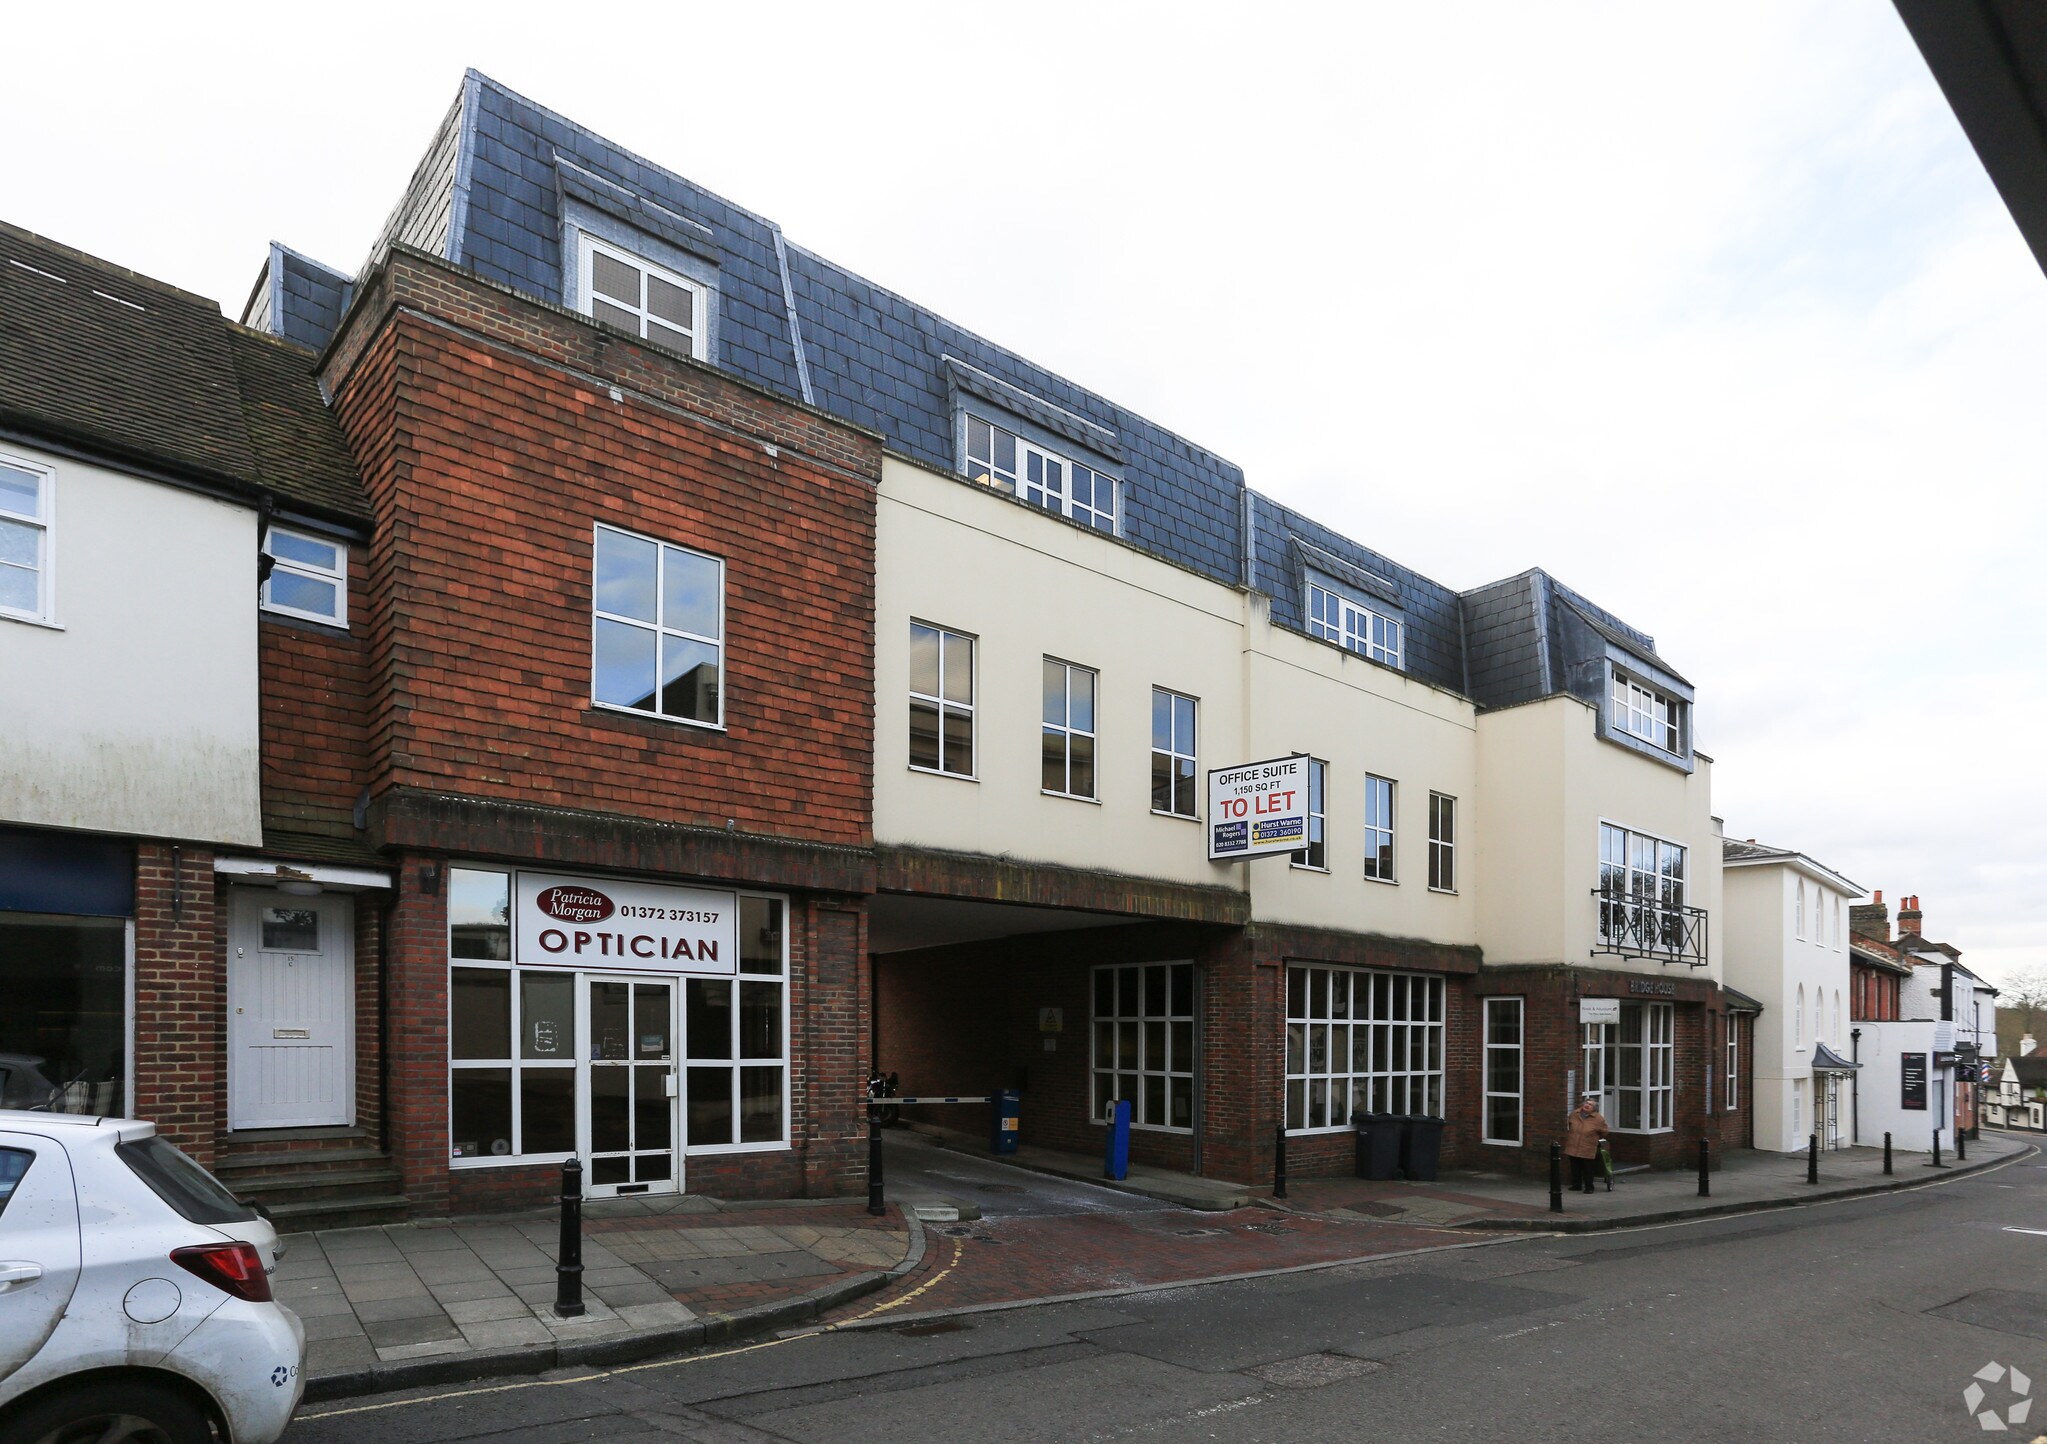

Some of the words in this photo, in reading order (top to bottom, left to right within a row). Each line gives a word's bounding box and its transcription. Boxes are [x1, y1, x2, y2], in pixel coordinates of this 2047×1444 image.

[1220, 769, 1259, 785] OFFICE
[1262, 763, 1297, 778] SUITE
[1234, 785, 1253, 795] 1,150
[1255, 782, 1268, 792] SQ
[1270, 781, 1281, 789] FT
[1221, 798, 1248, 819] TO
[1255, 790, 1296, 815] LET
[1216, 825, 1236, 833] Michael
[1260, 830, 1277, 838] 01372
[1280, 827, 1302, 835] 360190
[1261, 821, 1279, 829] Hurst
[1222, 831, 1240, 839] Rogers
[550, 889, 602, 906] Patricia
[550, 902, 601, 921] Morgan
[620, 906, 665, 920] 01372
[669, 909, 719, 924] 373157
[538, 929, 719, 962] OPTICIAN
[1630, 980, 1654, 994] BRIDGE
[1655, 982, 1676, 995] HOUSE
